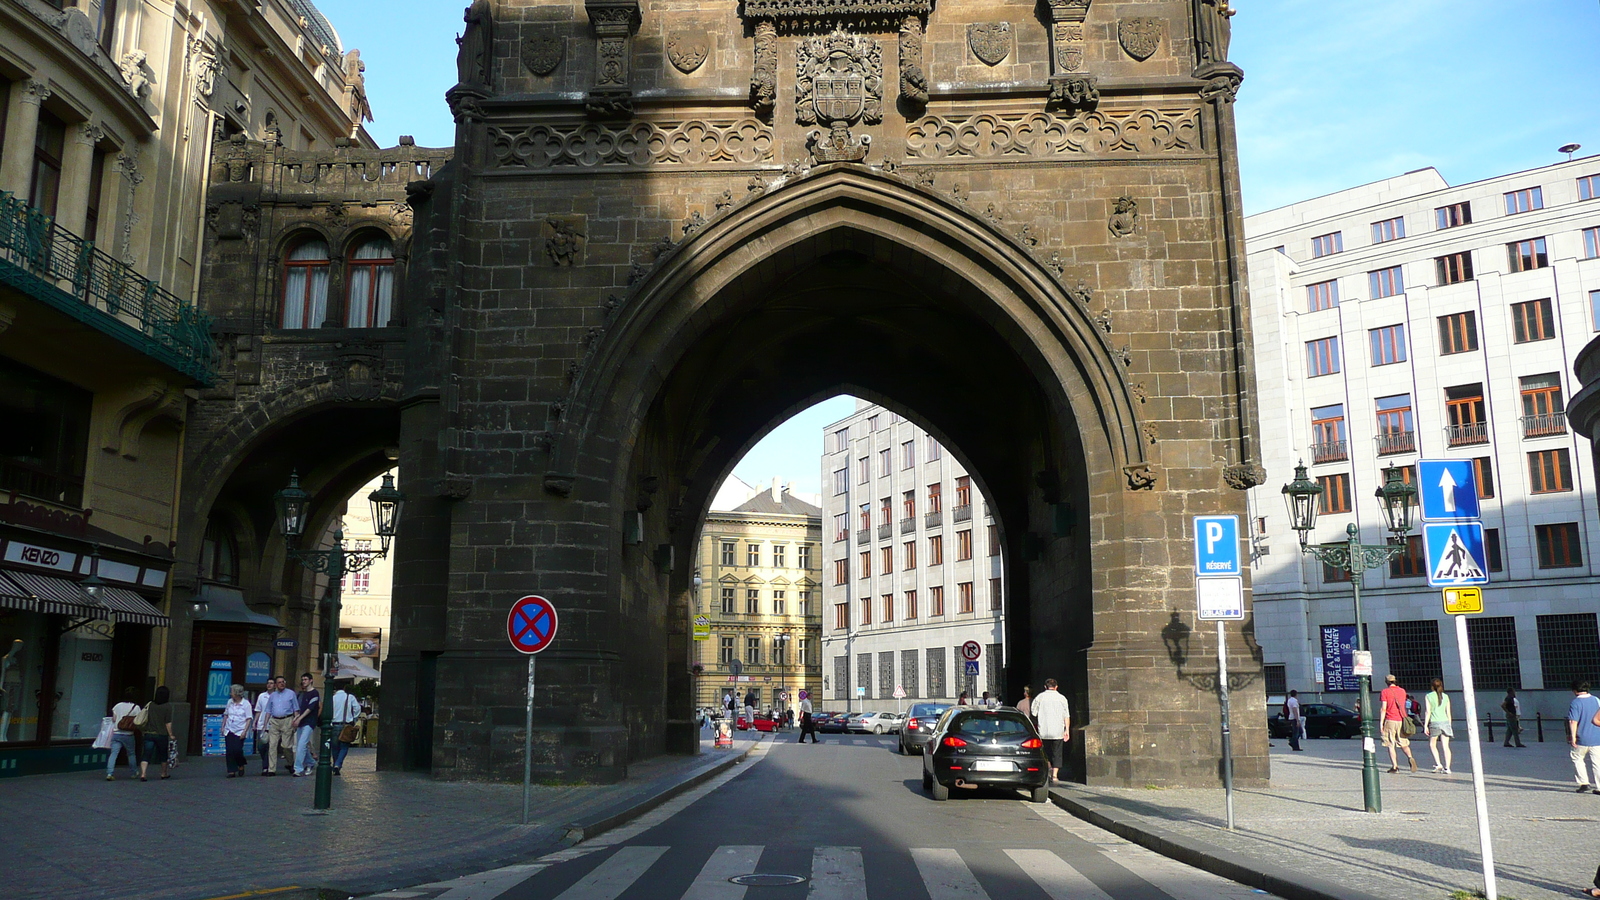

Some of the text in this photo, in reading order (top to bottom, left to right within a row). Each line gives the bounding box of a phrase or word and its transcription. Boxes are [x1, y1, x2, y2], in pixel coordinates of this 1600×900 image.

[1205, 522, 1223, 554] P
[21, 546, 60, 566] KENZO
[1205, 560, 1232, 570] RÉSERVÉ
[344, 603, 392, 617] BERNIA
[248, 660, 269, 670] CHANGE
[208, 673, 231, 697] 0%
[1327, 671, 1337, 690] LIDÉ
[1334, 664, 1344, 690] PEOPLE
